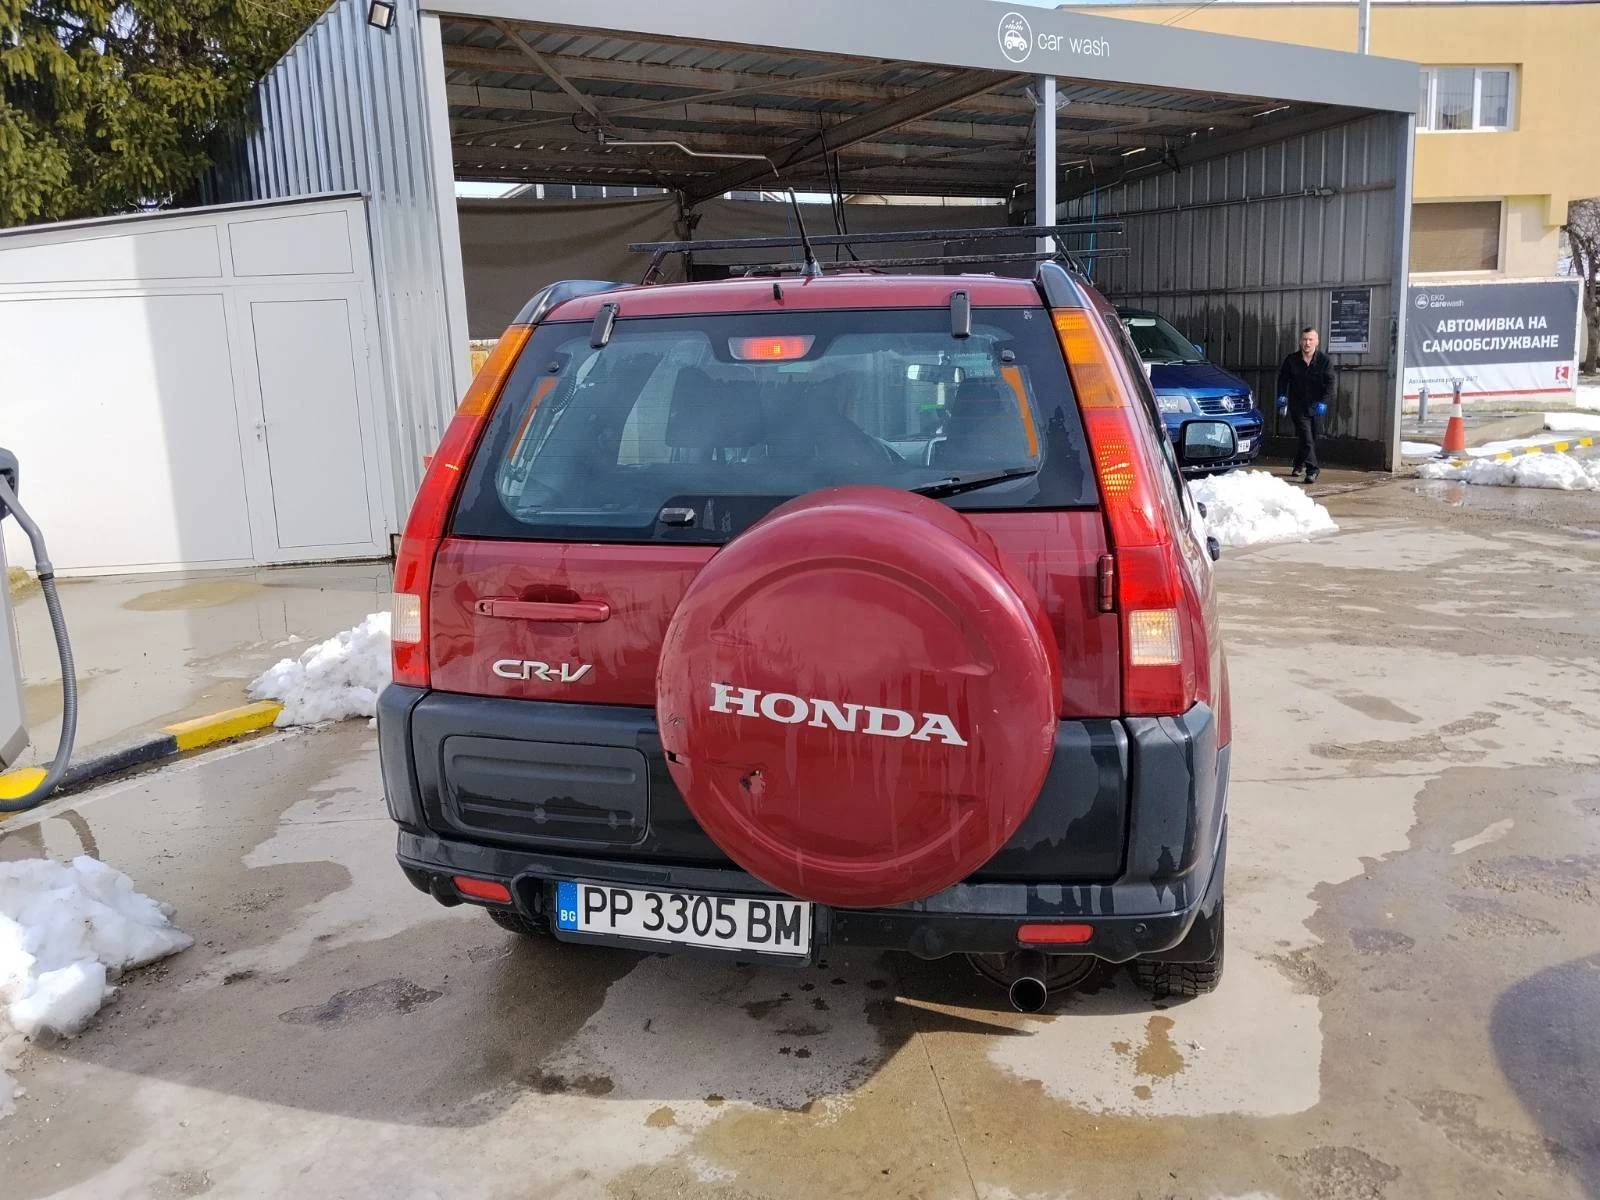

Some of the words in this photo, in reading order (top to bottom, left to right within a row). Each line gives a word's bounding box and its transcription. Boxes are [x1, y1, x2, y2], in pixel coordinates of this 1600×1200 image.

[1037, 33, 1063, 51] car
[1069, 36, 1110, 57] wash
[1436, 317, 1524, 333] АВТОМИВКА
[1529, 315, 1547, 330] НА
[1422, 335, 1559, 353] САМООБСЛУЖВАНЕ
[492, 659, 593, 682] CR-V
[709, 682, 968, 746] HONDA
[560, 909, 576, 922] BG
[584, 886, 633, 927] PP
[642, 893, 737, 940] 3305
[747, 901, 801, 946] BM
